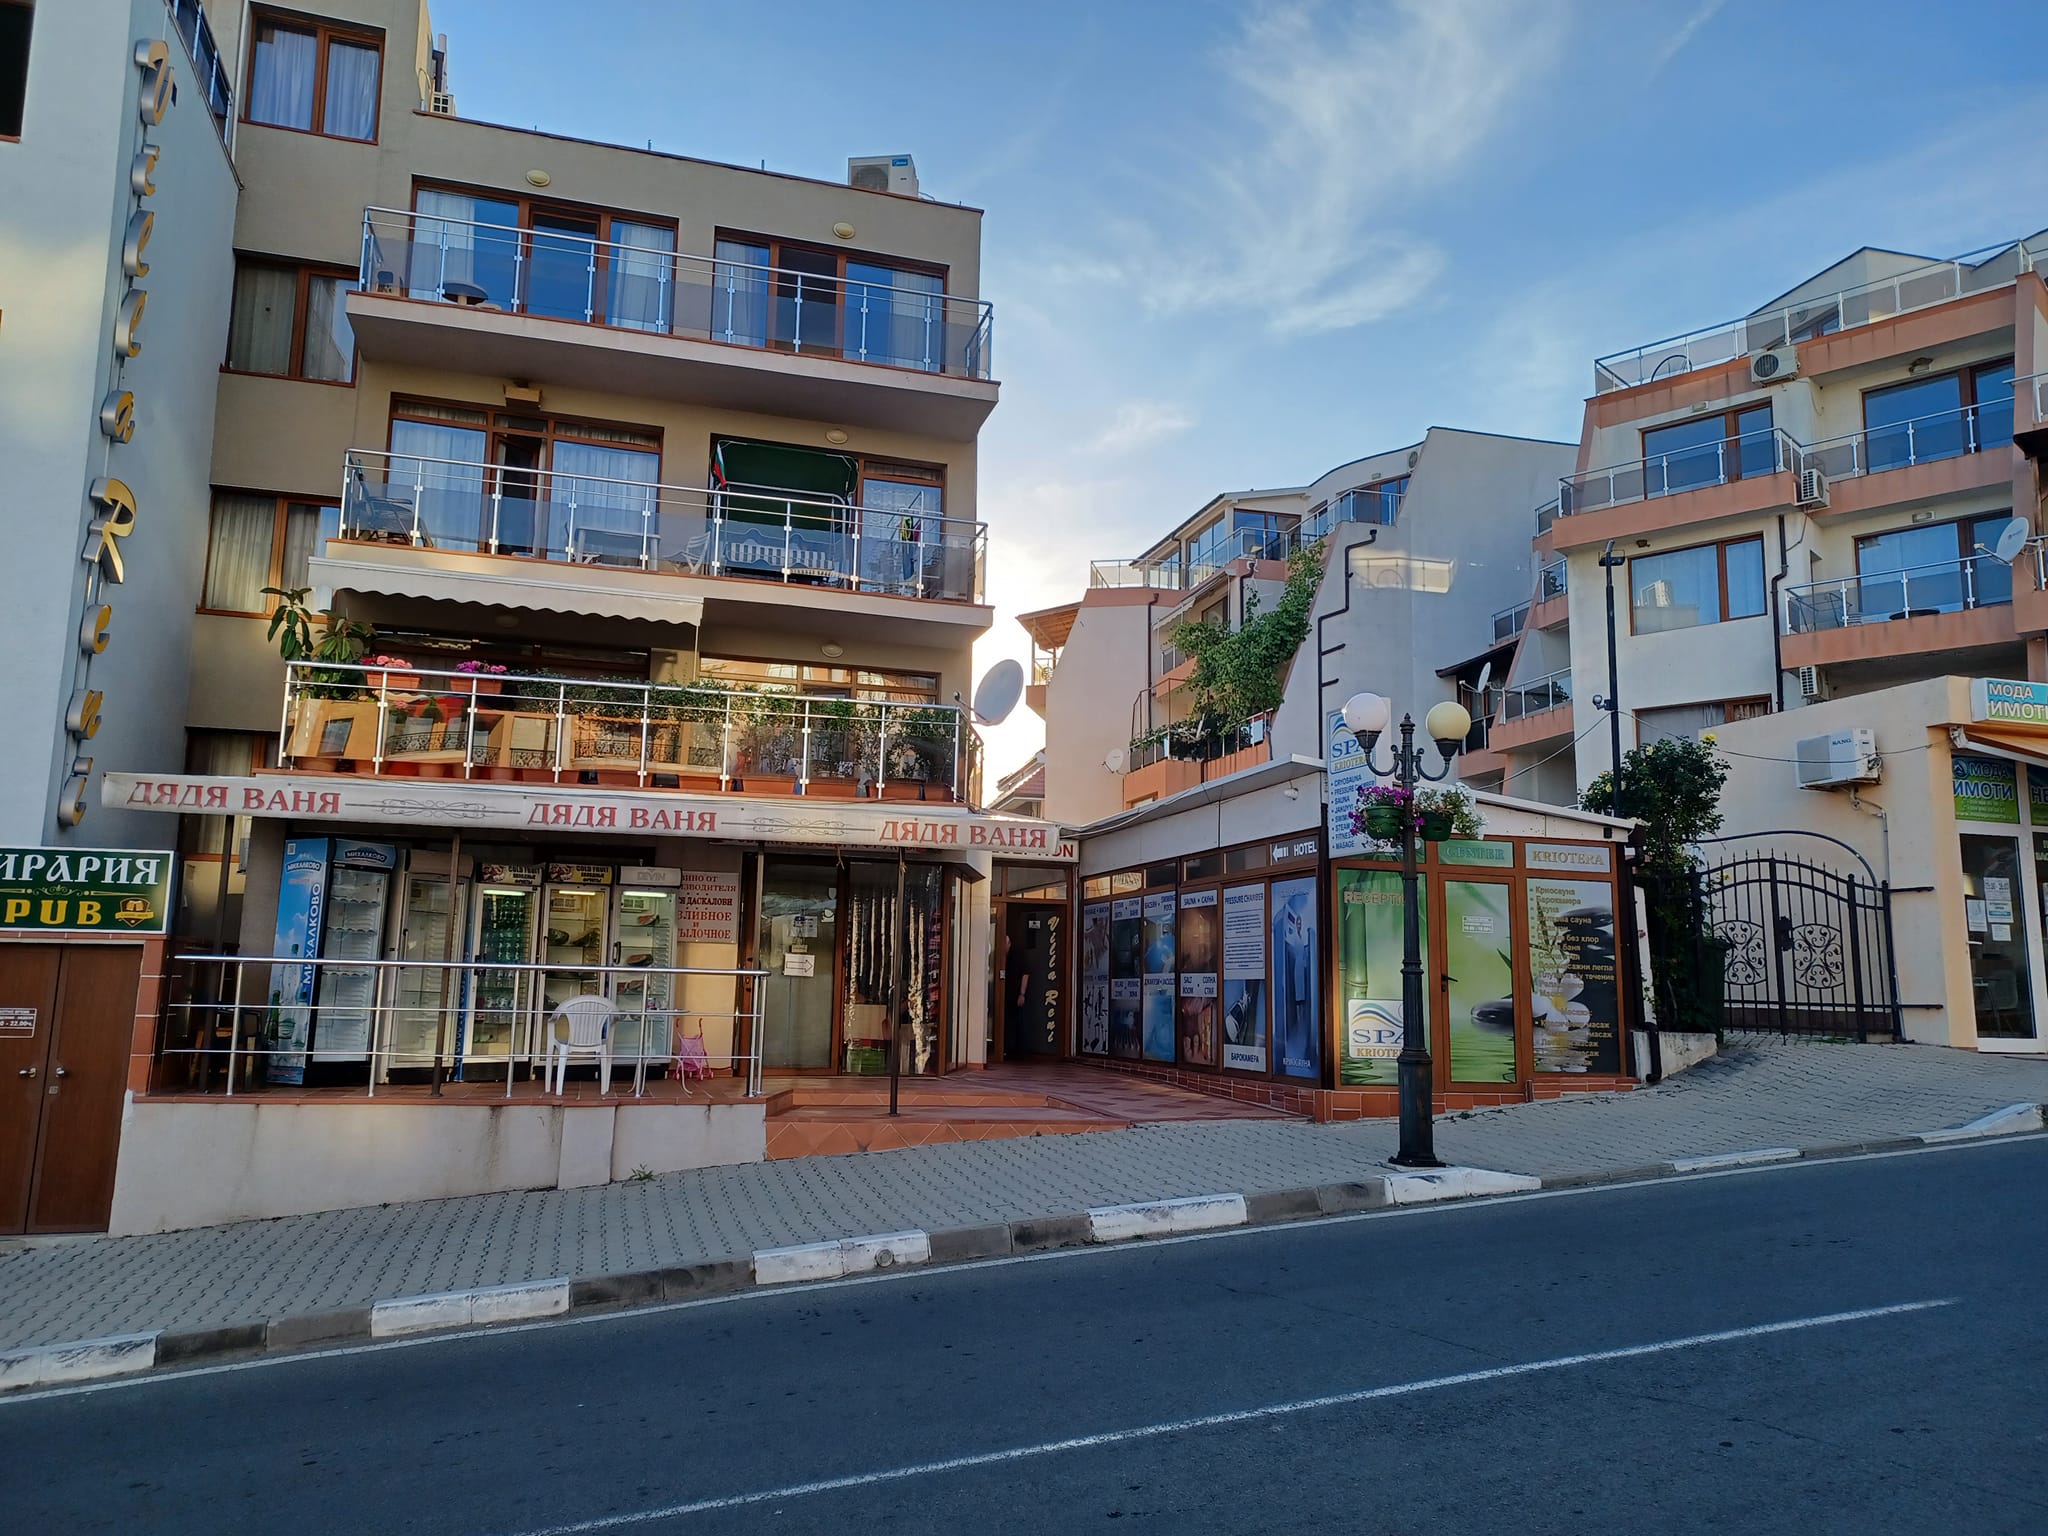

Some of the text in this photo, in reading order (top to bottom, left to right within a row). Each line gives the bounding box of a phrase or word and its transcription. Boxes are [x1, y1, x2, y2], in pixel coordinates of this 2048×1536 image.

[1989, 683, 2034, 699] МОДА
[1970, 762, 2009, 778] МОДА
[127, 781, 341, 814] ДЯДЯ ВАНЯ
[1953, 780, 2013, 800] ИМОТИ
[1335, 796, 1350, 804] SAUNA
[527, 803, 717, 832] ДЯДЯ ВАНЯ
[879, 821, 1046, 848] ДЯДЯ ВАНЯ
[1293, 841, 1318, 857] HOTEL
[1446, 848, 1505, 861] CENTER
[1532, 850, 1605, 866] KRIOTERA
[1536, 886, 1576, 896] Криосауна
[4, 898, 102, 925] PUB
[1570, 917, 1592, 925] сауна
[1567, 934, 1580, 942] без
[1581, 936, 1600, 944] хлор
[1592, 963, 1613, 971] легла
[1356, 1047, 1402, 1058] KRIOTE
